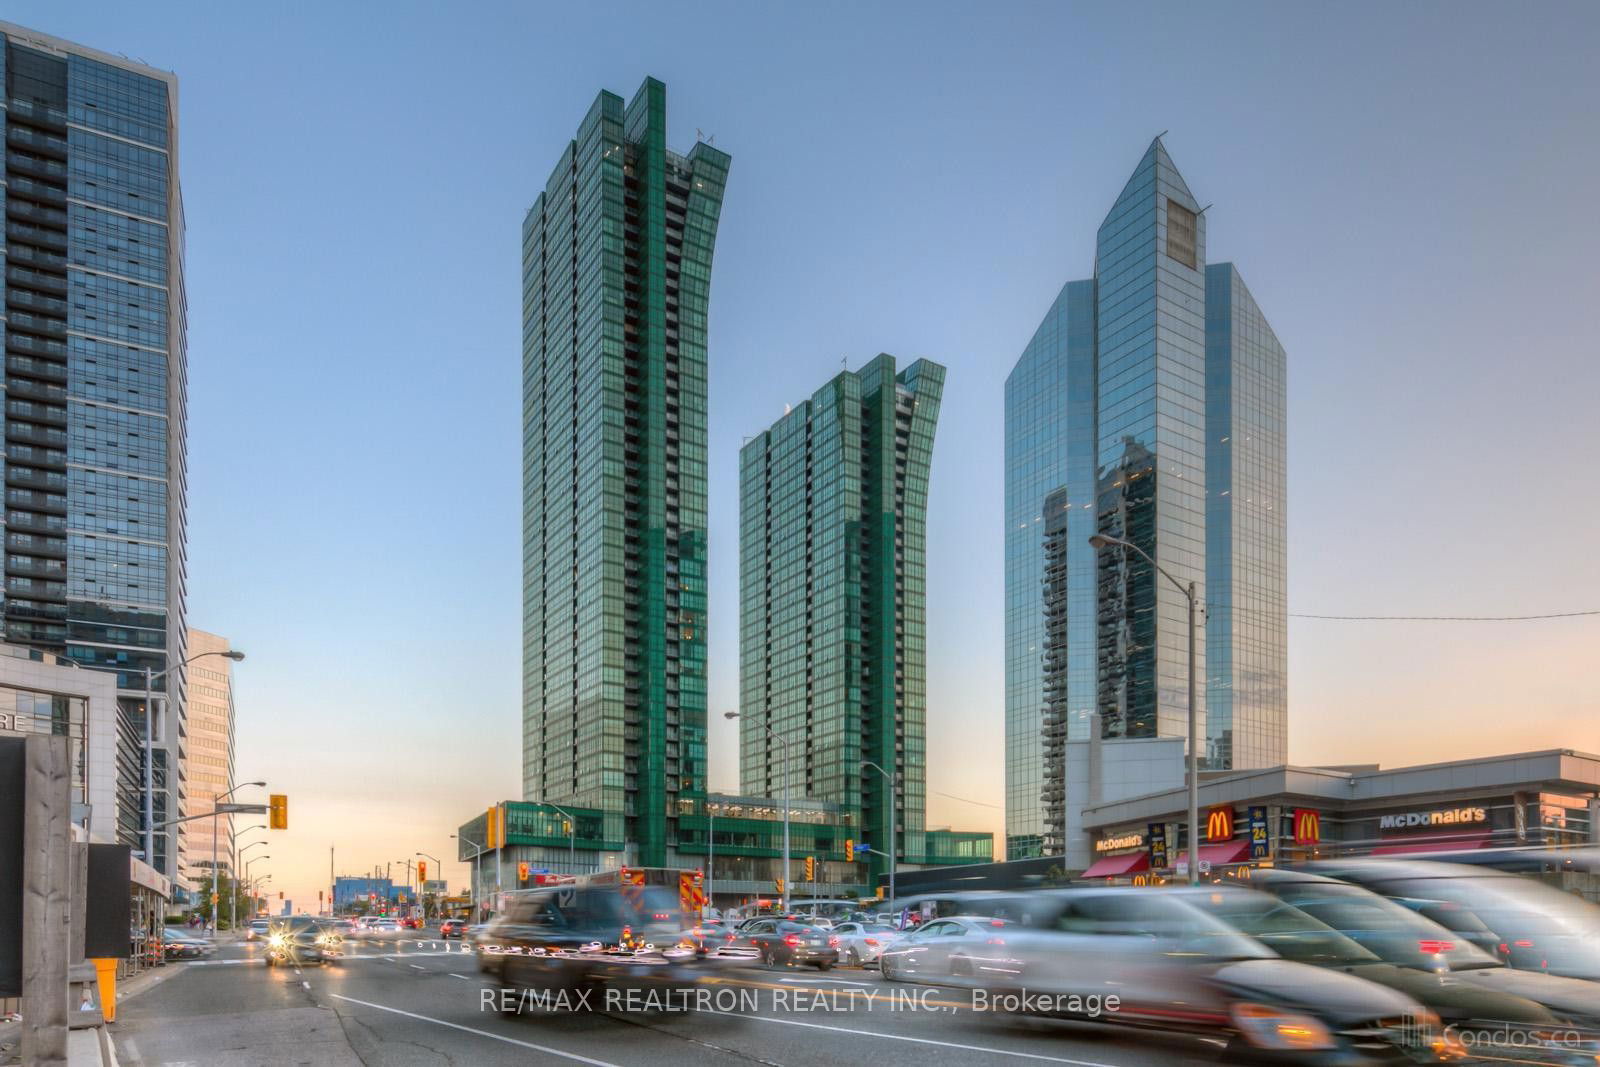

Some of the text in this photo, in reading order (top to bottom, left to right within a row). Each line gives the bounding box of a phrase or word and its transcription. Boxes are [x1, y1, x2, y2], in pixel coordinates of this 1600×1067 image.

[1380, 808, 1486, 829] McDonald's
[1096, 834, 1143, 852] McDonald's
[1252, 828, 1266, 841] 24
